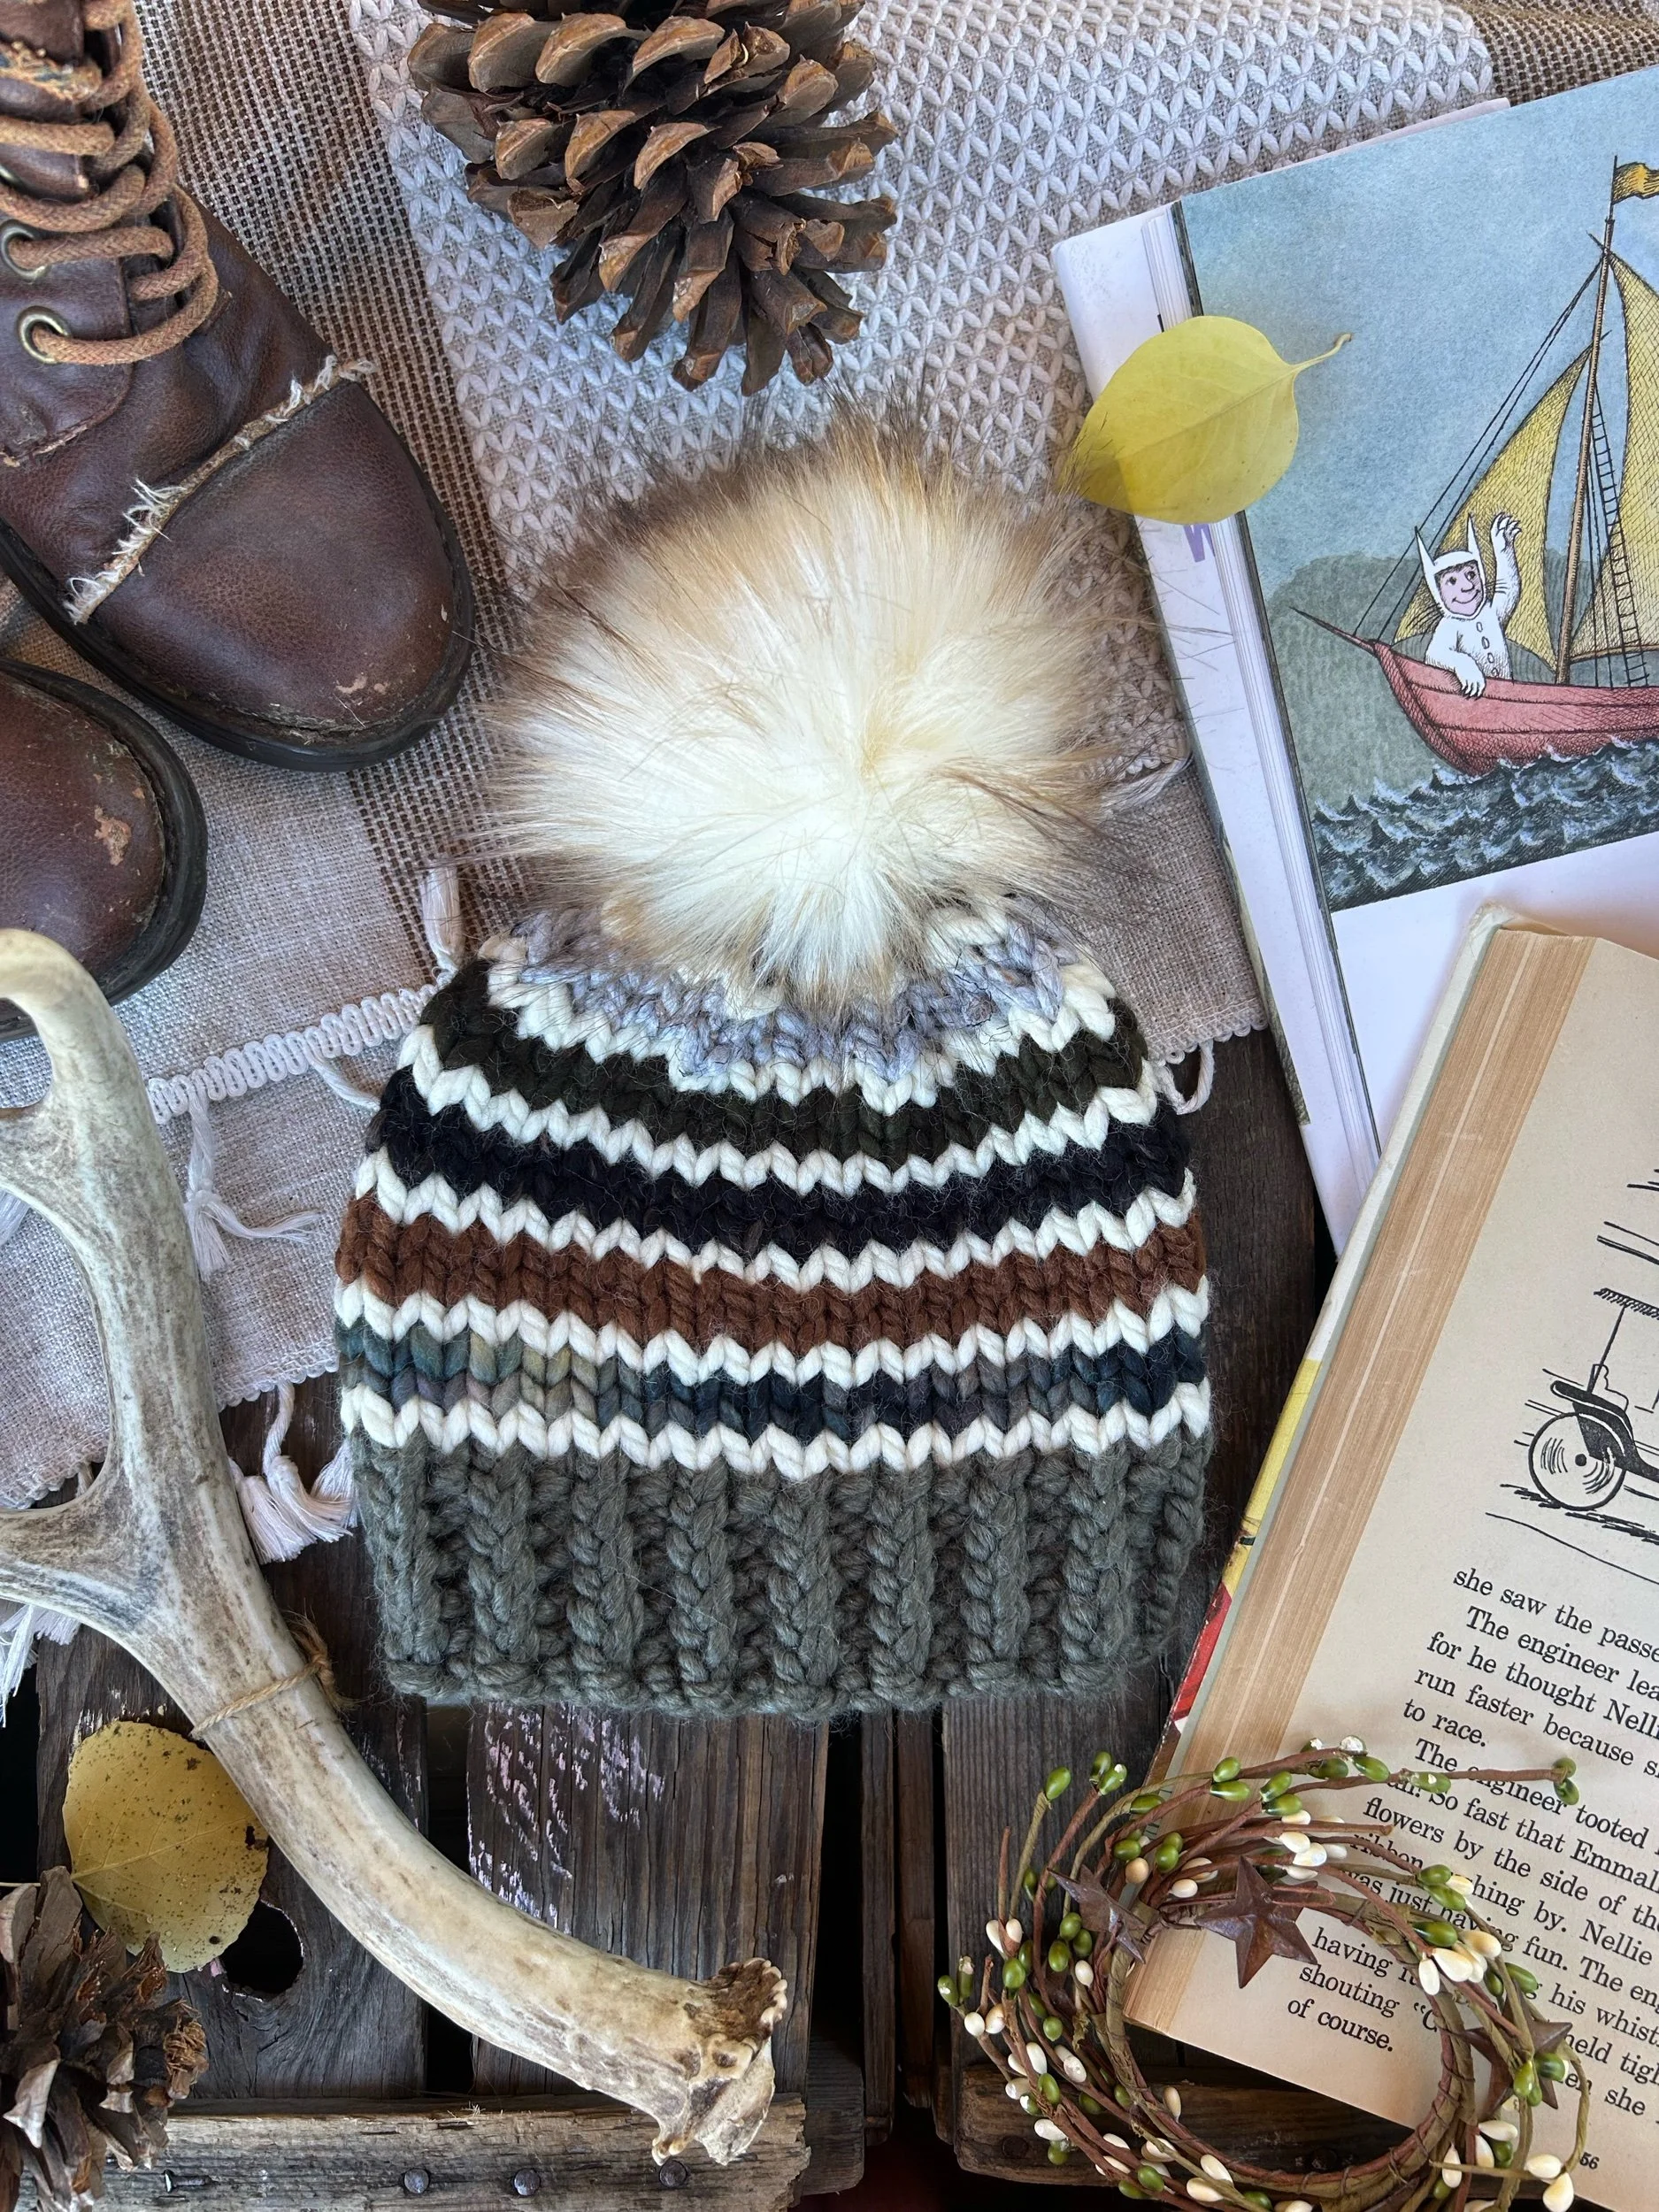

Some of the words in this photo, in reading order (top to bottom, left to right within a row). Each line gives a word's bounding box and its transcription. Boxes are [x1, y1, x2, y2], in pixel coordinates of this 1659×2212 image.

[1453, 1568, 1494, 1596] she
[1500, 1588, 1548, 1617] saw
[1554, 1604, 1593, 1634] the
[1426, 1631, 1462, 1660] for
[1467, 1645, 1497, 1674] he
[1505, 1662, 1597, 1713] thought
[1466, 1605, 1509, 1640] The
[1517, 1633, 1620, 1683] engineer
[1402, 1698, 1426, 1722] to
[1432, 1714, 1486, 1747] race.
[1414, 1669, 1456, 1698] run
[1465, 1684, 1534, 1726] faster
[1543, 1713, 1634, 1767] because
[1415, 1738, 1458, 1772] The
[1575, 1804, 1649, 1849] tooted
[1363, 1796, 1445, 1844] flowers
[1454, 1830, 1484, 1861] by
[1493, 1847, 1532, 1878] the
[1540, 1870, 1589, 1901] side
[1598, 1894, 1627, 1916] of
[1463, 1797, 1510, 1832] fast
[1515, 1818, 1566, 1854] that
[1570, 1838, 1659, 1895] Emmal
[1311, 1926, 1393, 1978] having
[1386, 1881, 1433, 1915] just
[1440, 1906, 1519, 1953] havg
[1523, 1936, 1568, 1971] fun.
[1578, 1955, 1624, 1993] The
[1533, 1900, 1567, 1932] by.
[1578, 1918, 1653, 1966] Nellie
[1287, 1998, 1315, 2018] of
[1317, 2010, 1393, 2053] course.
[1299, 1963, 1400, 2018] shouting
[1604, 2086, 1647, 2116] she
[1548, 1982, 1586, 2016] his
[1596, 2007, 1659, 2047] whist
[1578, 2151, 1601, 2170] 56
